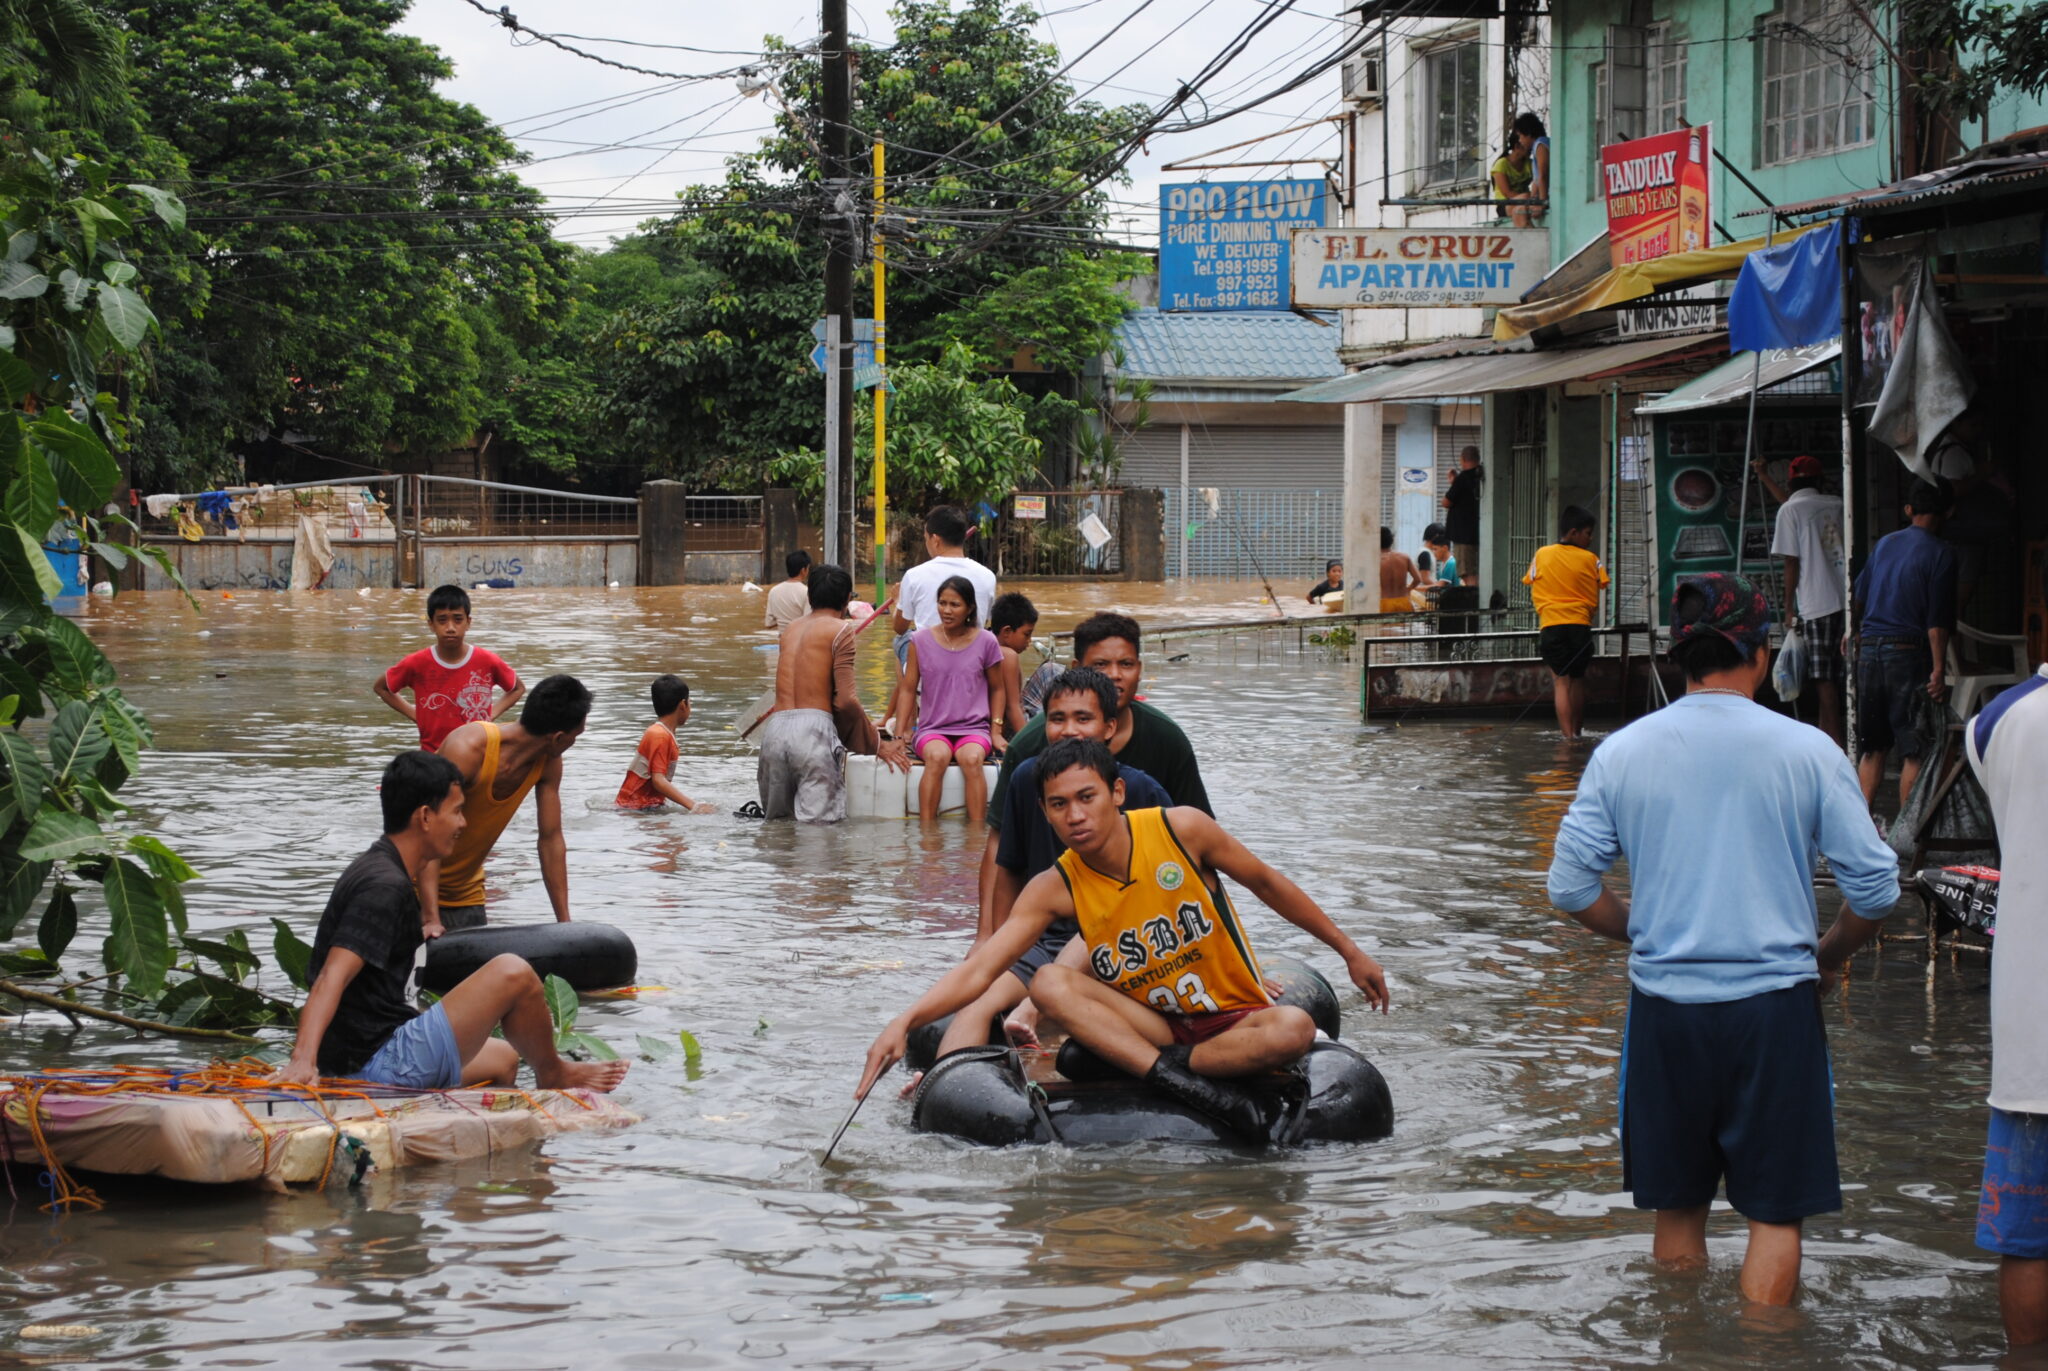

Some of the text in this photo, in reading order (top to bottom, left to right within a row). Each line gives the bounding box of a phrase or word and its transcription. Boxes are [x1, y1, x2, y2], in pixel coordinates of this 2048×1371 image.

[1606, 150, 1678, 196] TANDUAY
[1168, 183, 1316, 222] PRO FLOW
[1610, 194, 1639, 219] RHUM
[1639, 192, 1646, 217] 5
[1646, 186, 1679, 213] YEARS
[1168, 221, 1207, 245] PURE
[1210, 220, 1272, 244] DRINKING
[1196, 243, 1283, 259] WE DELIVER:
[1398, 234, 1515, 261] CRUZ
[1318, 262, 1515, 289] APARTMENT
[466, 554, 523, 576] GUNS
[1120, 948, 1203, 992] CENTURIONS
